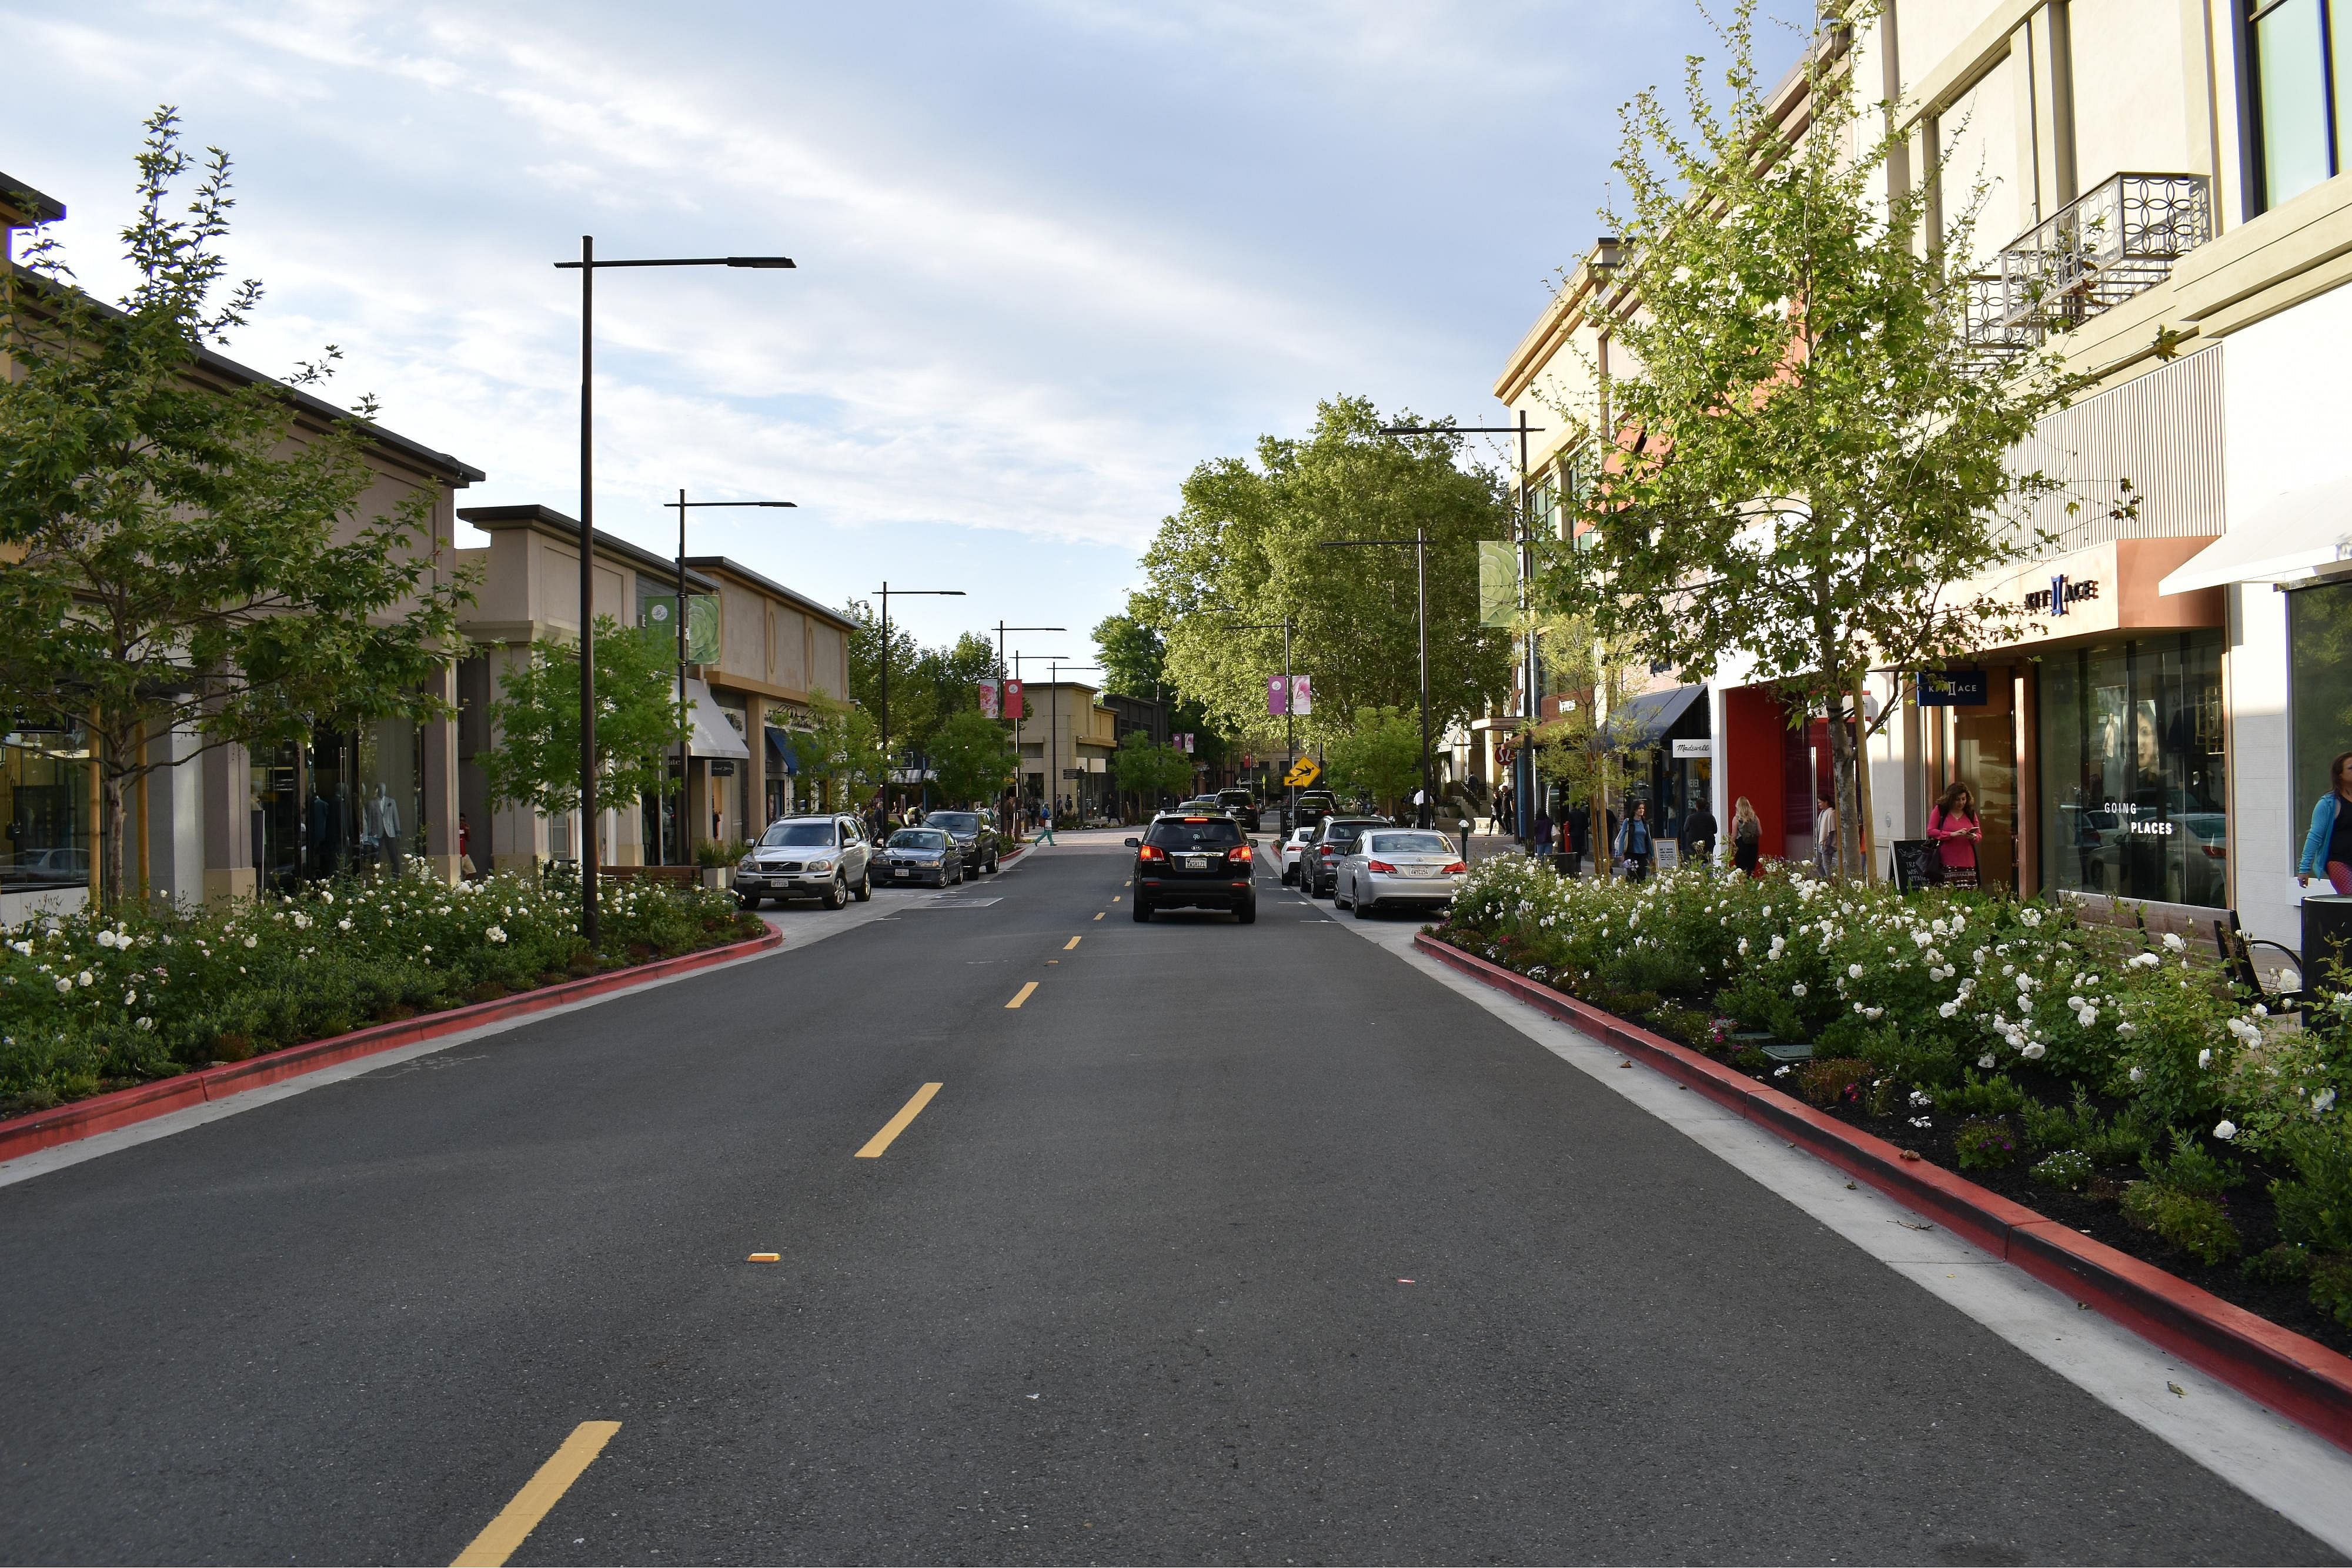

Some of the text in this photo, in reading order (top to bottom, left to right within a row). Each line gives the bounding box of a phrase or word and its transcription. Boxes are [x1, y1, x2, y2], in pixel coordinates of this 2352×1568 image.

[2064, 580, 2096, 602] ACE
[2105, 803, 2136, 814] GOING
[2131, 822, 2172, 835] PLACES
